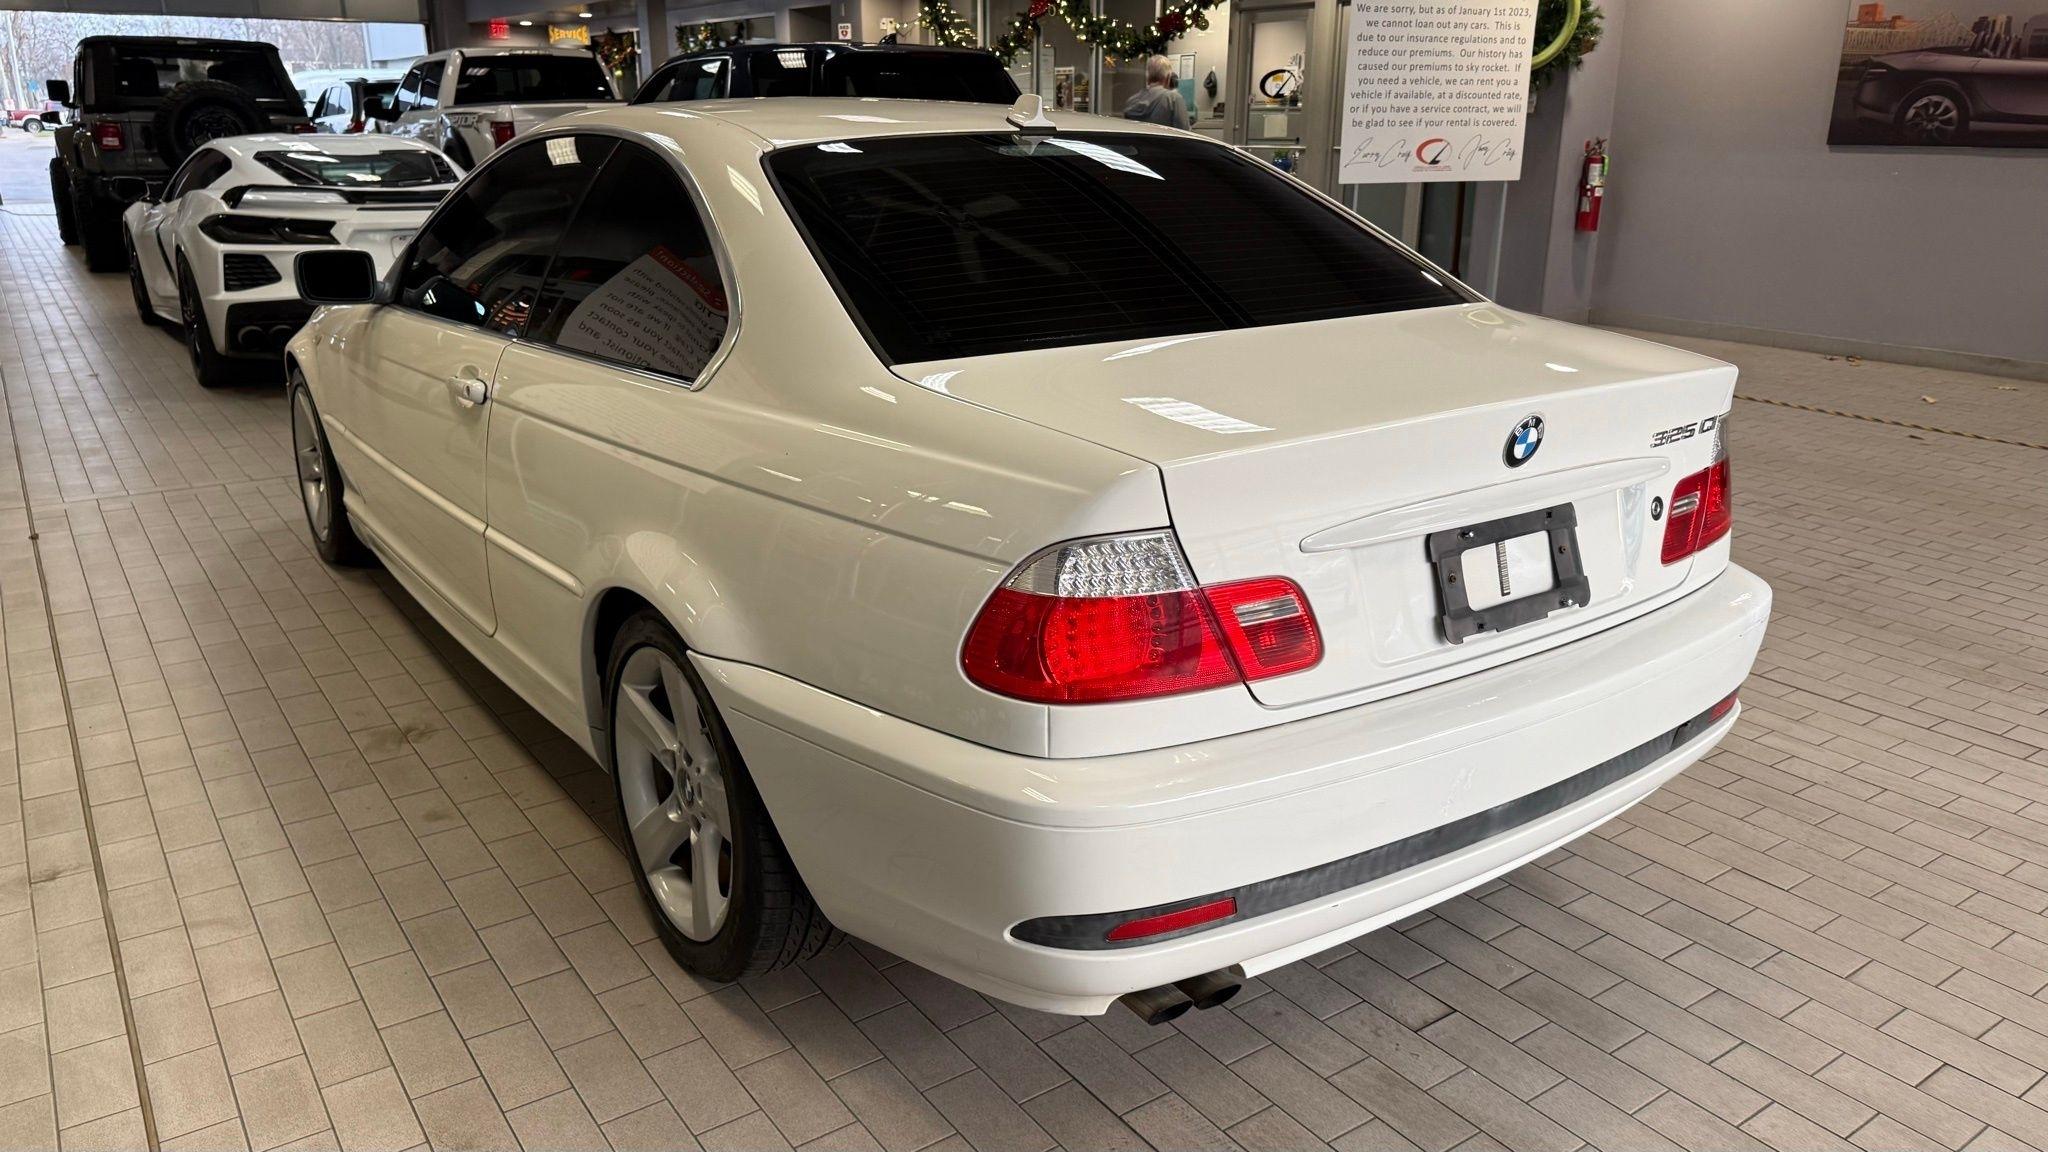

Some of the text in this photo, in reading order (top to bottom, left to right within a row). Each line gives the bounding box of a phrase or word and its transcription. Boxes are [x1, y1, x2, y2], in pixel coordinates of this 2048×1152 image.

[1356, 3, 1532, 18] We are sorry, but as of January 1st 2023,
[1366, 19, 1520, 32] we cannot loan out any cars. This is
[548, 25, 591, 46] SERVICE
[1356, 33, 1526, 47] due to our insurance regulations and to
[1358, 47, 1389, 57] reduce
[1391, 49, 1407, 57] our
[1460, 48, 1476, 58] Our
[1478, 48, 1506, 61] history
[1509, 49, 1523, 59] has
[1358, 61, 1522, 74] caused our premiums to sky rocket. If
[1358, 76, 1518, 88] you need a vehicle, we can rent you a
[1350, 90, 1522, 101] vehicle if available, at a discounted rate,
[1350, 104, 1522, 116] or if you have a service contract, we will
[1352, 117, 1517, 130] be glad to see if your rental is covered.
[1650, 422, 1698, 448] 325
